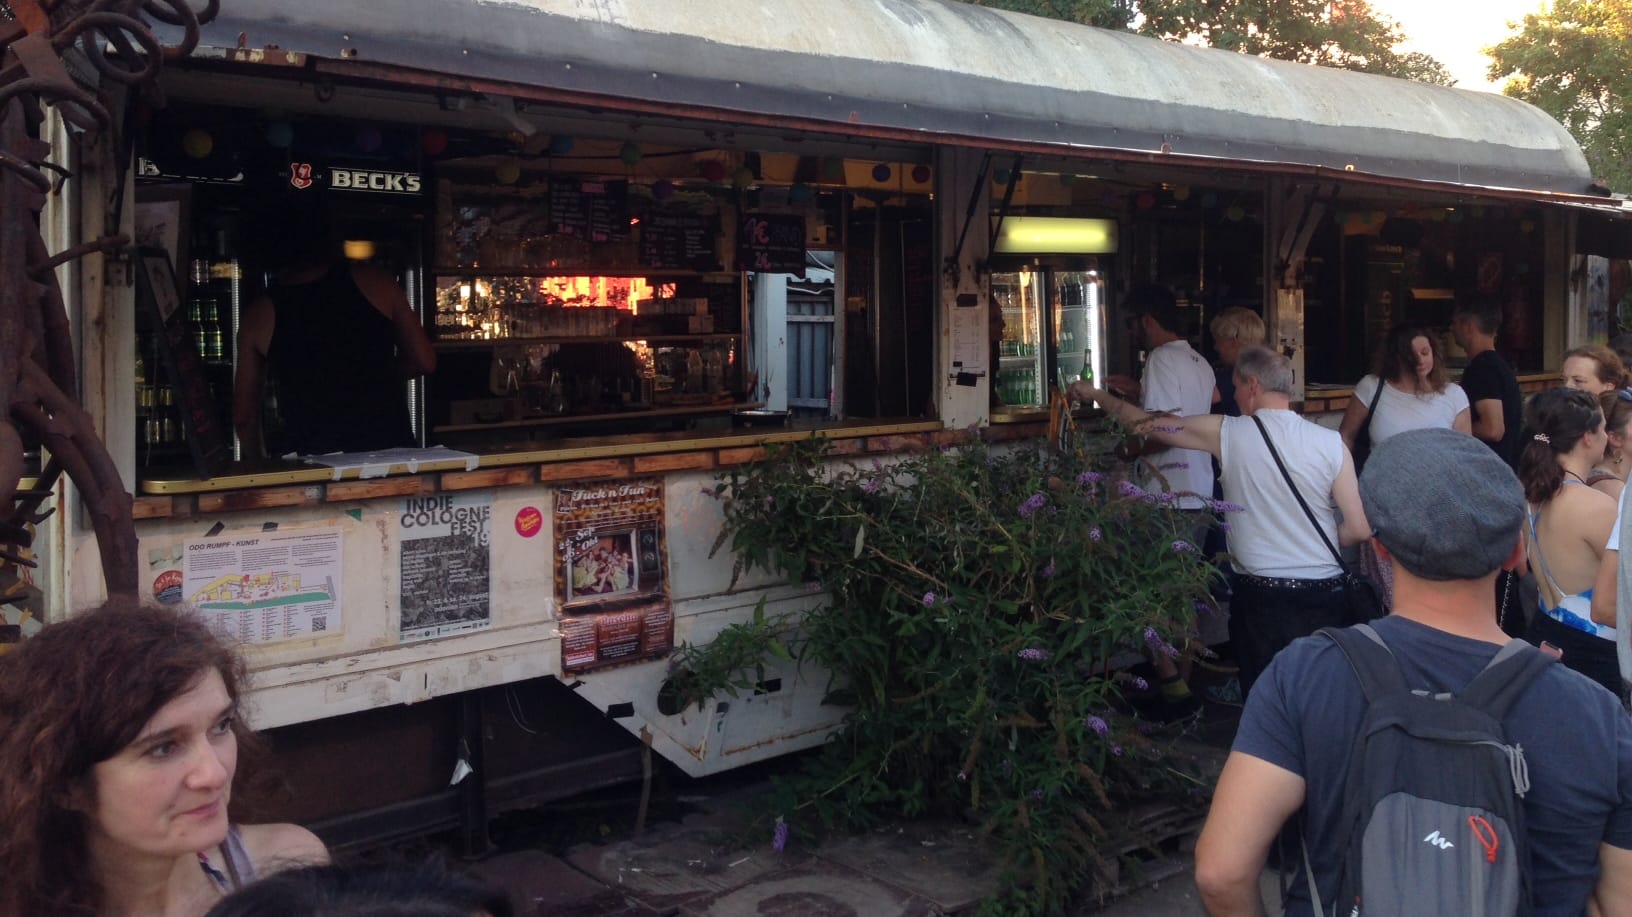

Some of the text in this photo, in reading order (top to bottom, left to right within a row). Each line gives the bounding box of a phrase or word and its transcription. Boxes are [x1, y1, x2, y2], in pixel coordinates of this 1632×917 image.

[332, 170, 421, 192] BECK'S
[406, 495, 453, 514] INDIE
[400, 506, 490, 528] COLOGNE
[451, 518, 487, 536] FEST
[206, 541, 231, 550] RUMPF
